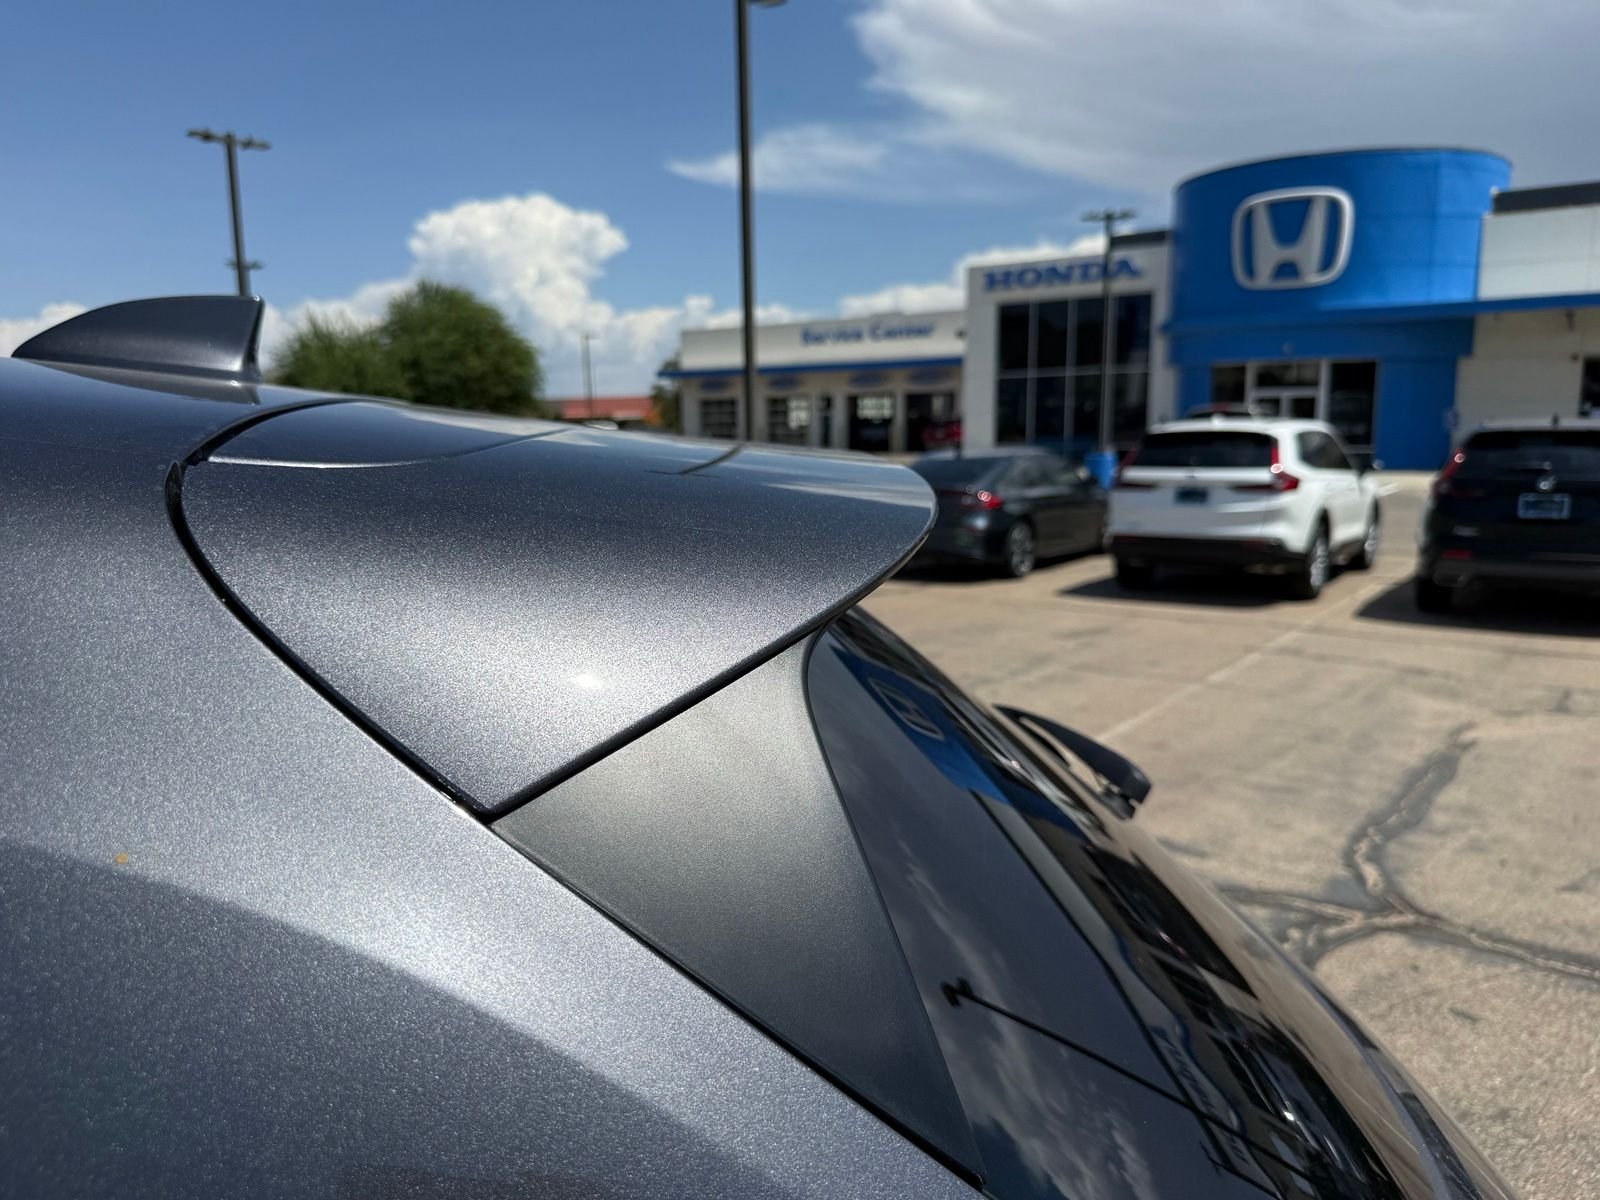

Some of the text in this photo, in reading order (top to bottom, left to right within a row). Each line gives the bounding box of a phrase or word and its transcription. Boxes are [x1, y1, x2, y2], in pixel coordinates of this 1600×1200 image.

[984, 260, 1142, 291] HONDA
[801, 320, 935, 345] Service Center
